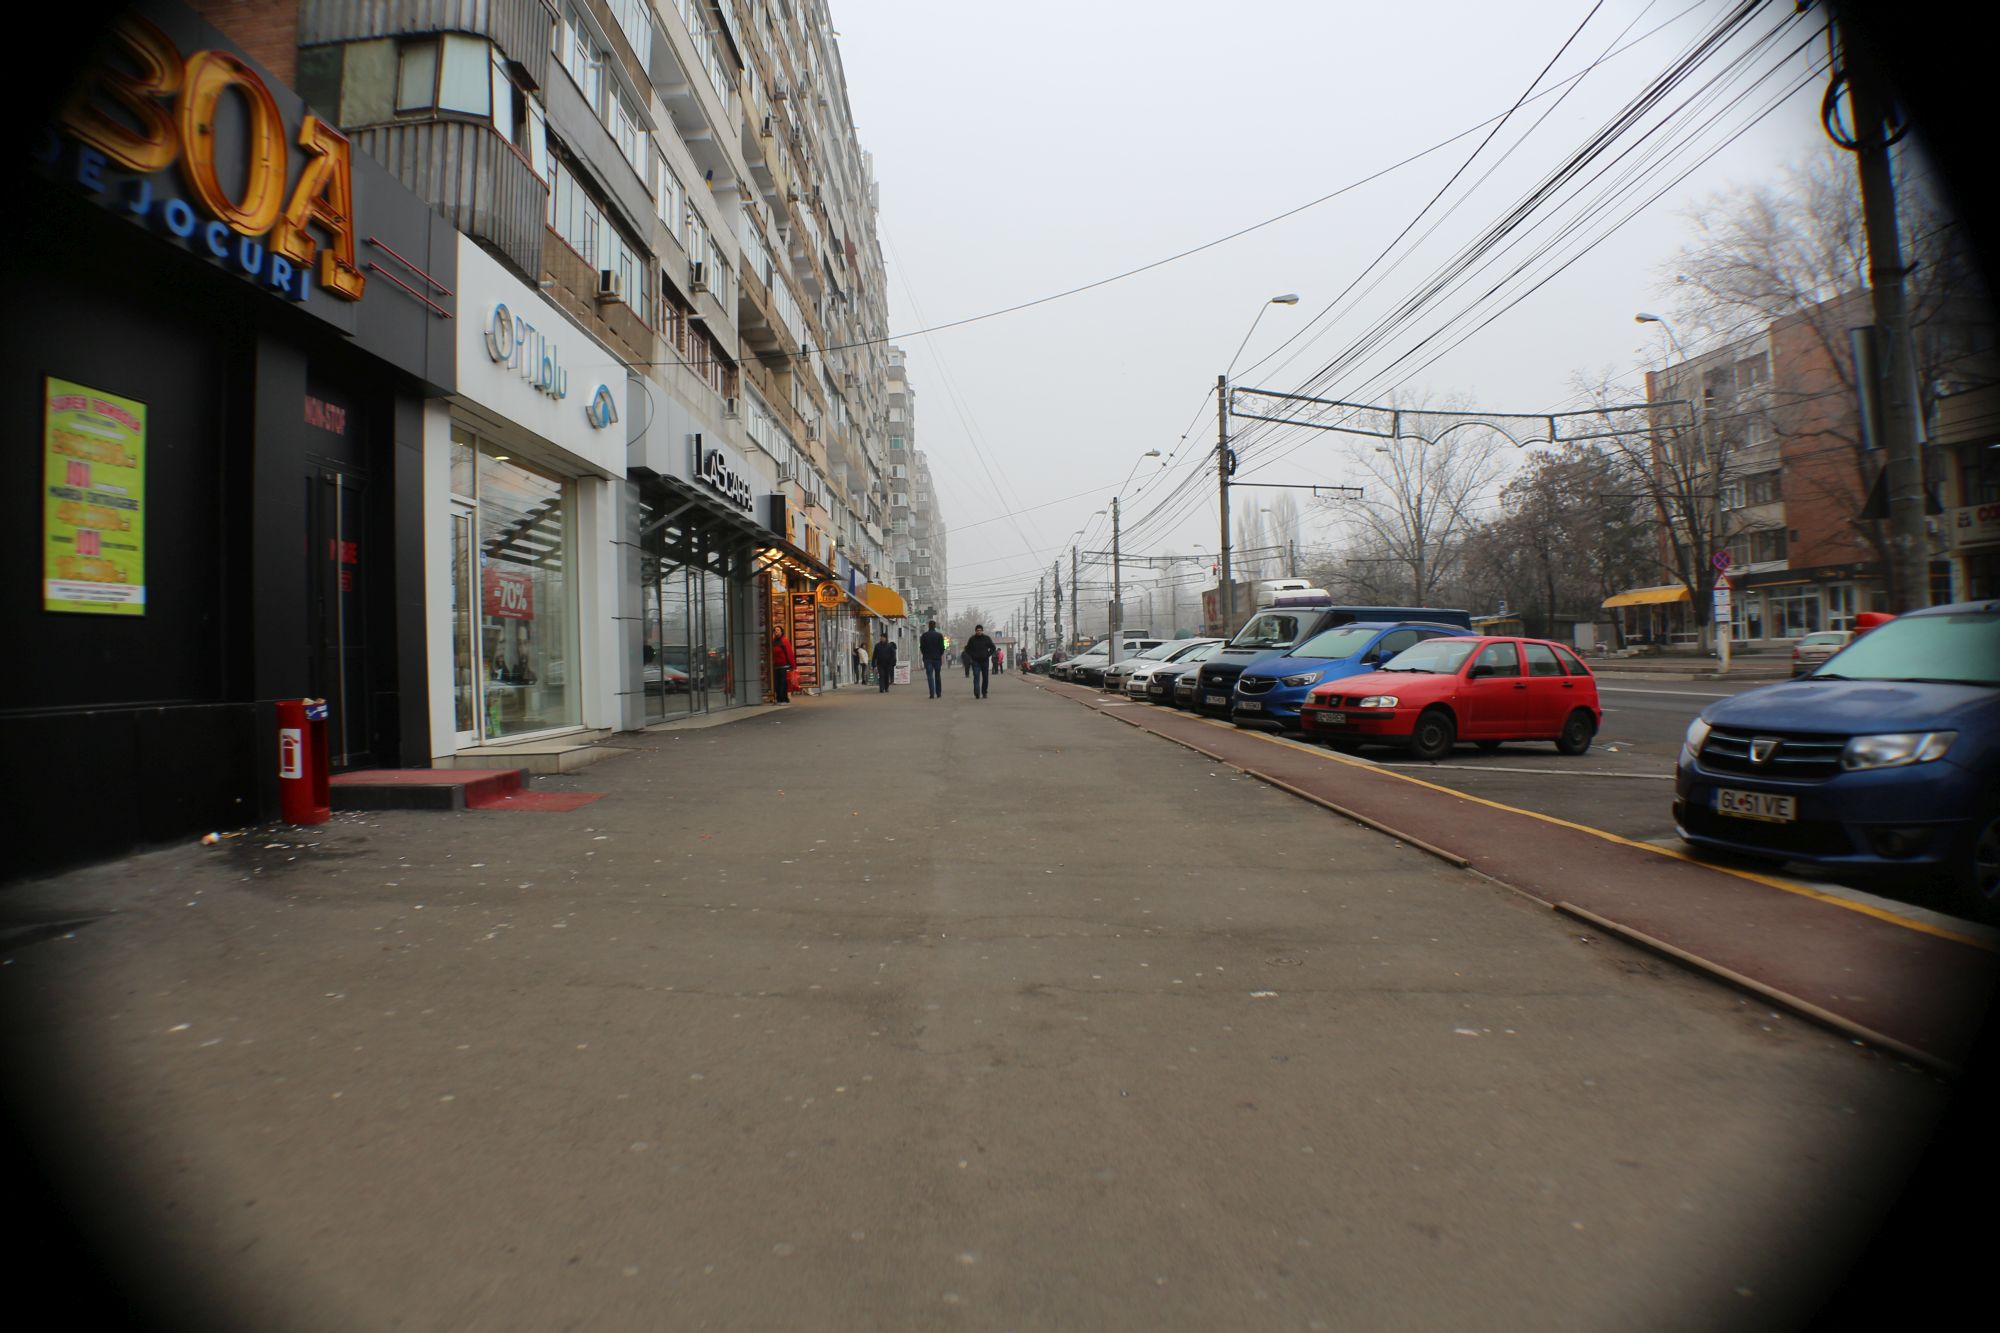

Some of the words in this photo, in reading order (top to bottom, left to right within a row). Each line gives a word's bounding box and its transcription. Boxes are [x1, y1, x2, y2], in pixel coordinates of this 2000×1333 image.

[52, 8, 366, 302] BOA
[129, 180, 311, 302] JOCURI
[494, 580, 527, 610] -70%
